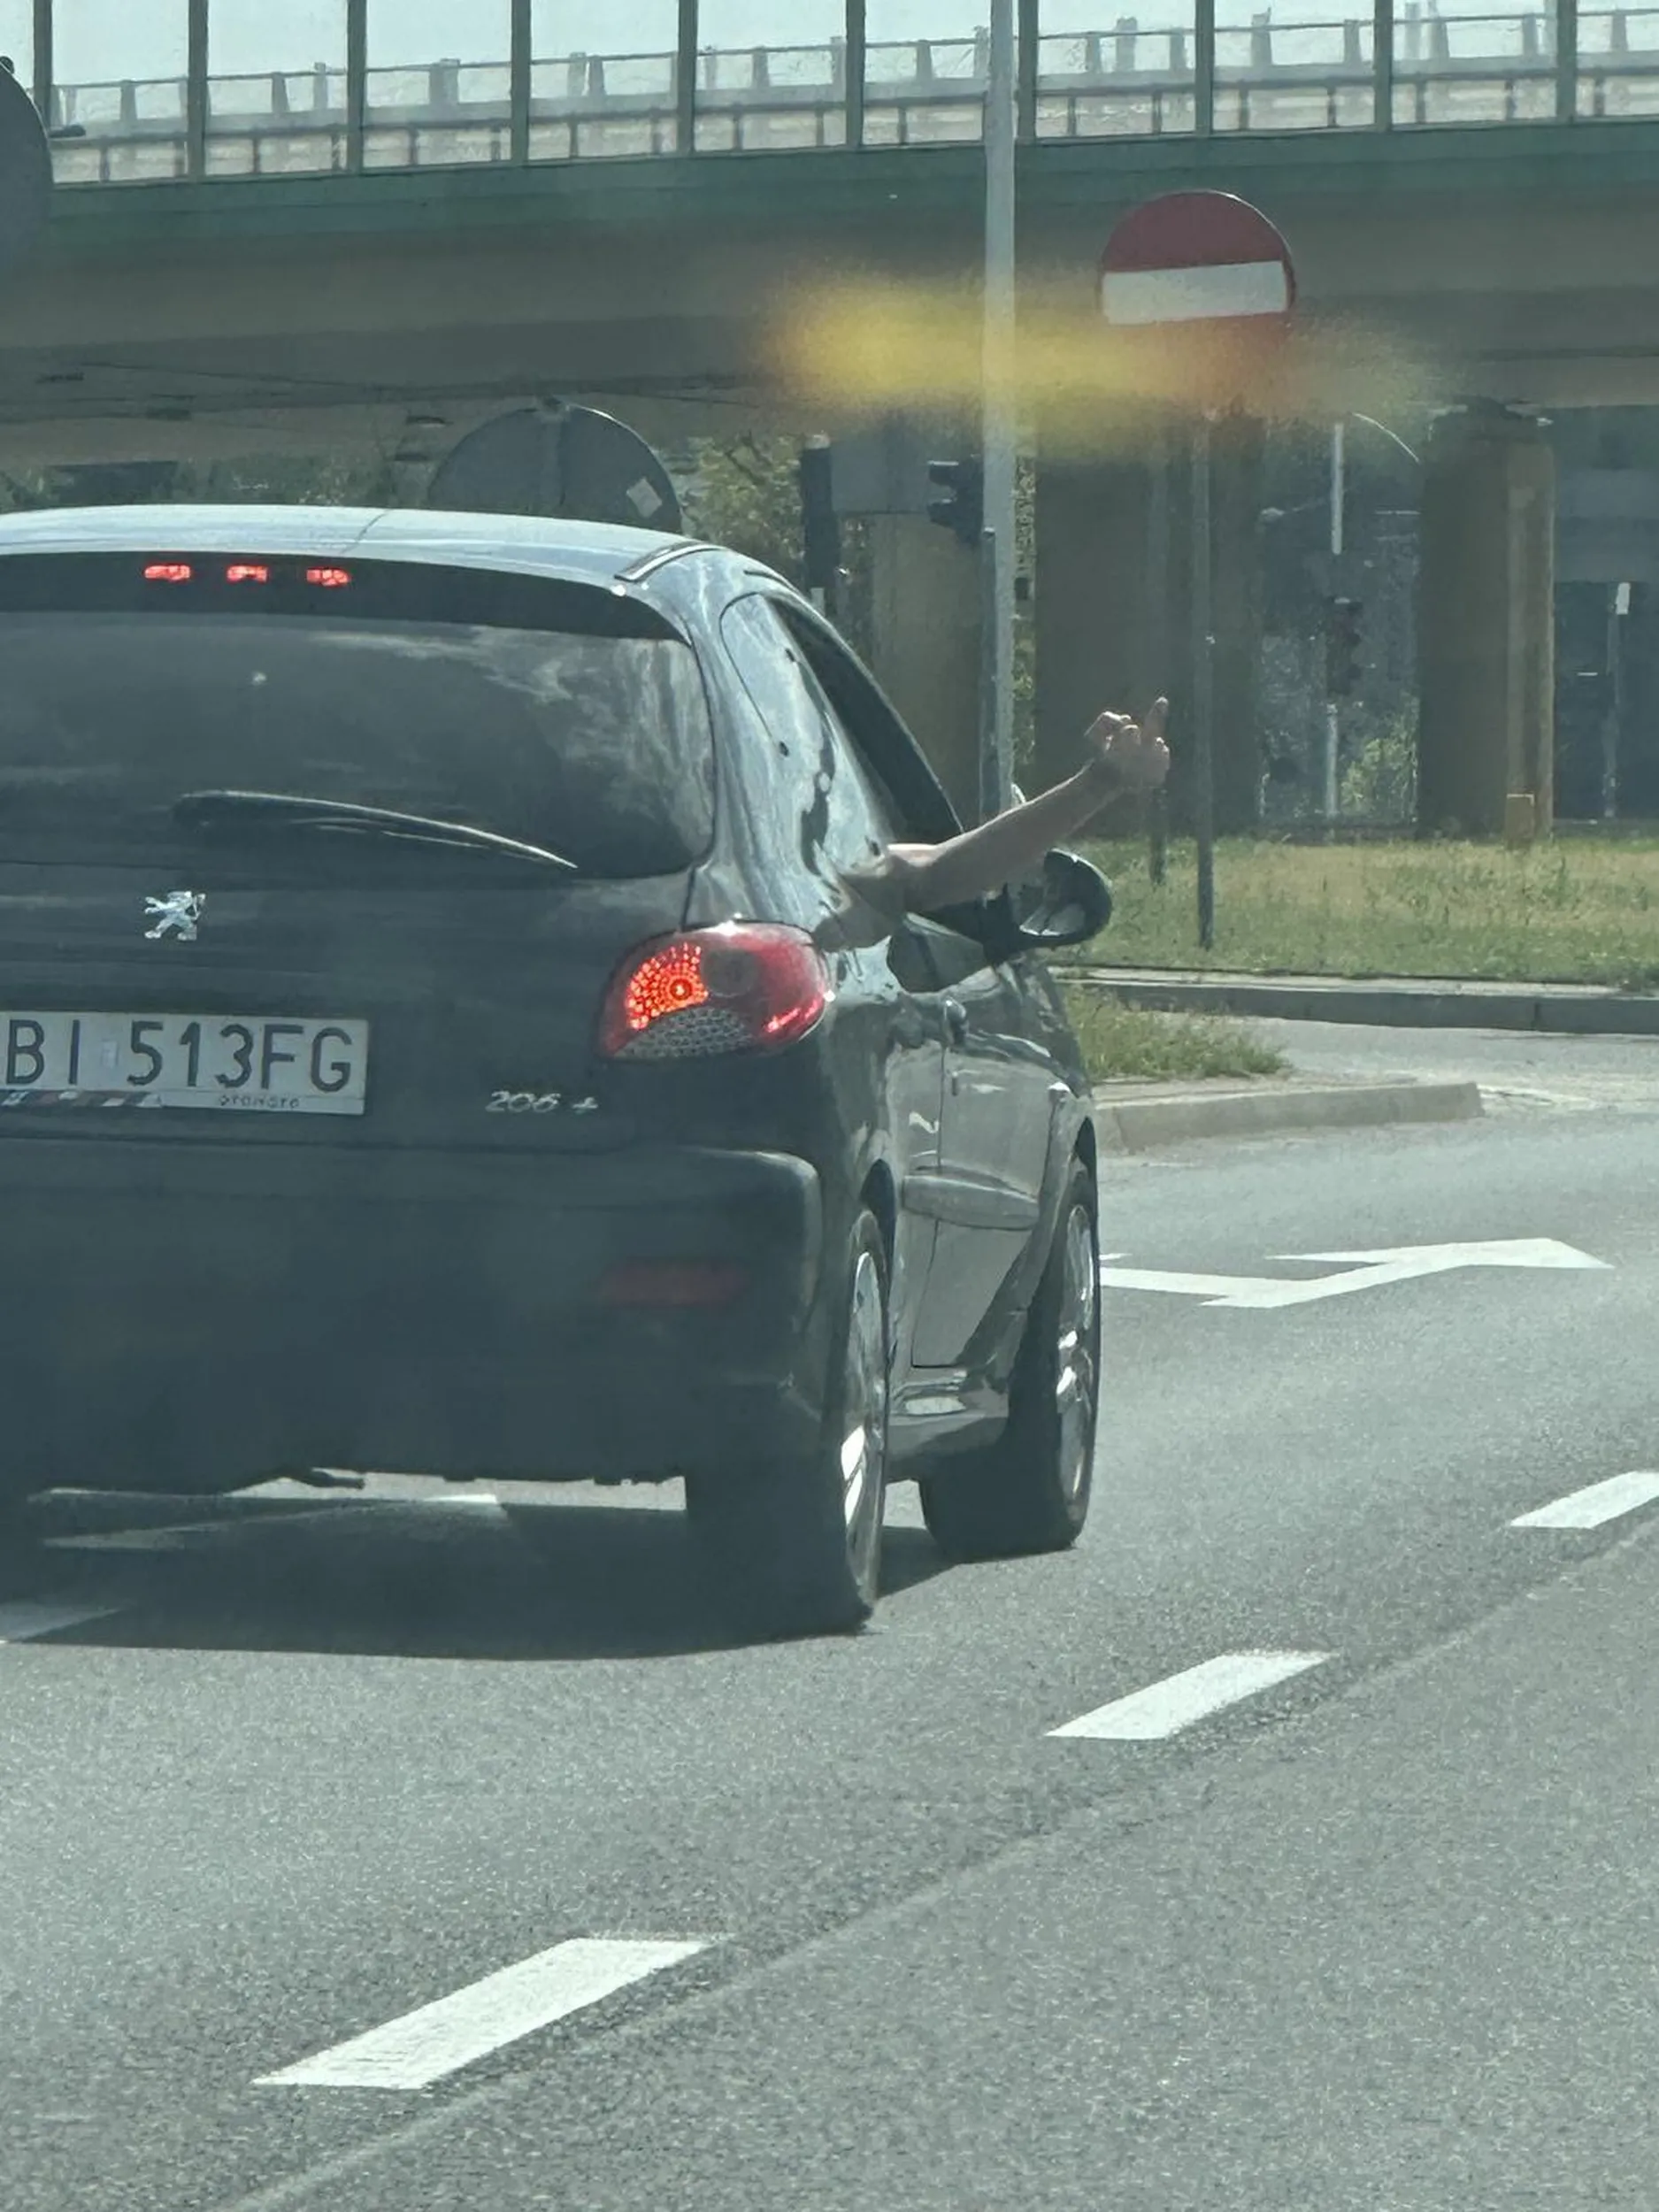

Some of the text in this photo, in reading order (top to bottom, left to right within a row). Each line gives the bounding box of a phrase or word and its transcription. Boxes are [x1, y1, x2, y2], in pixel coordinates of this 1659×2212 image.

[6, 1019, 353, 1093] BI 513FG
[486, 1090, 561, 1113] 206
